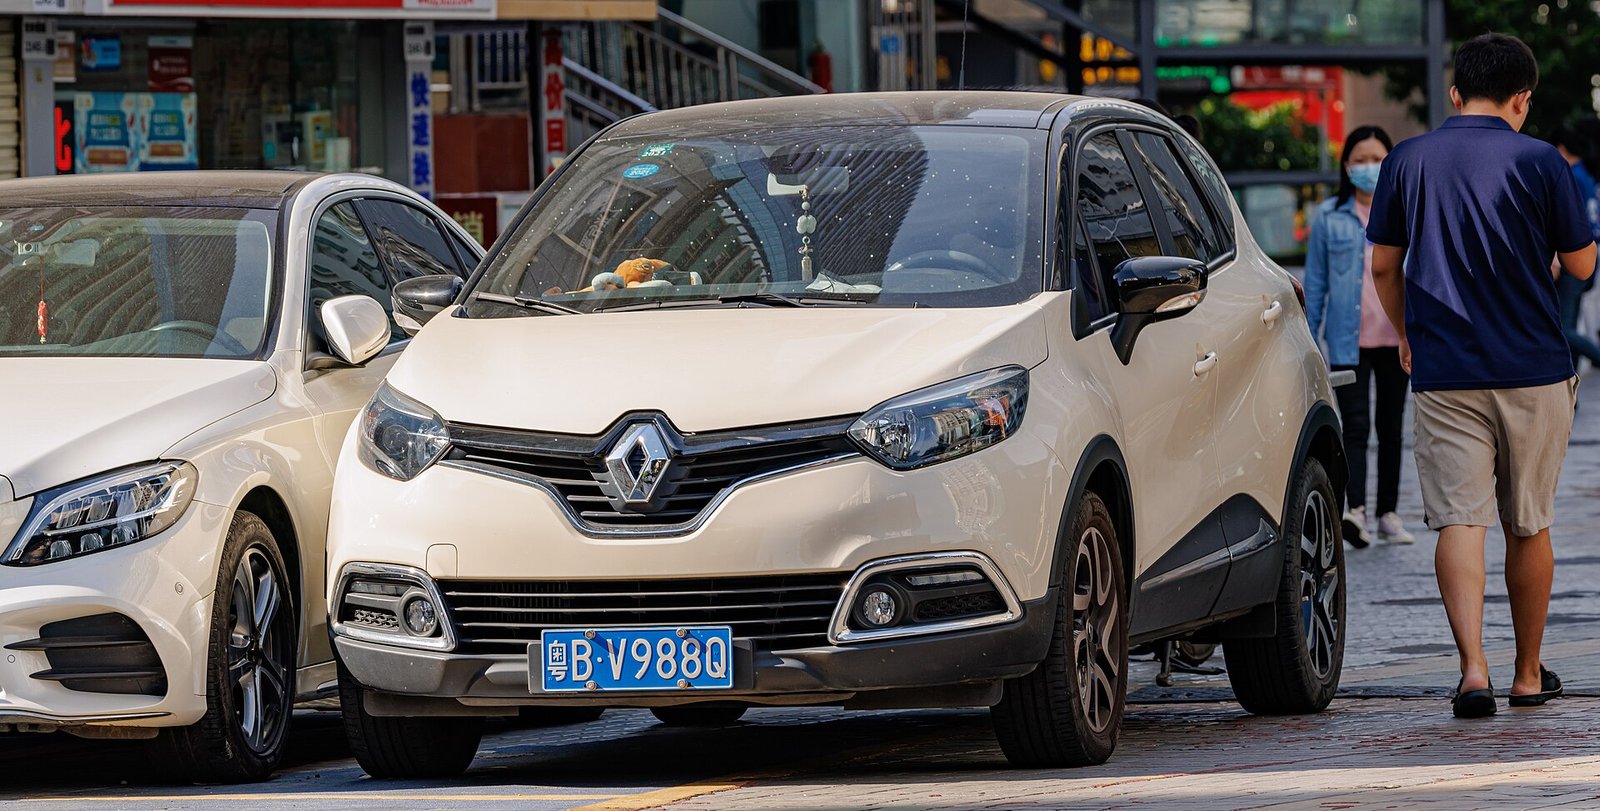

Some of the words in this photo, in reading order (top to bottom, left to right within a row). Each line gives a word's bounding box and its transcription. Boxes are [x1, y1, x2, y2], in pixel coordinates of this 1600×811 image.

[543, 28, 565, 174] 高价回
[547, 637, 727, 682] 粤B·V988Q
